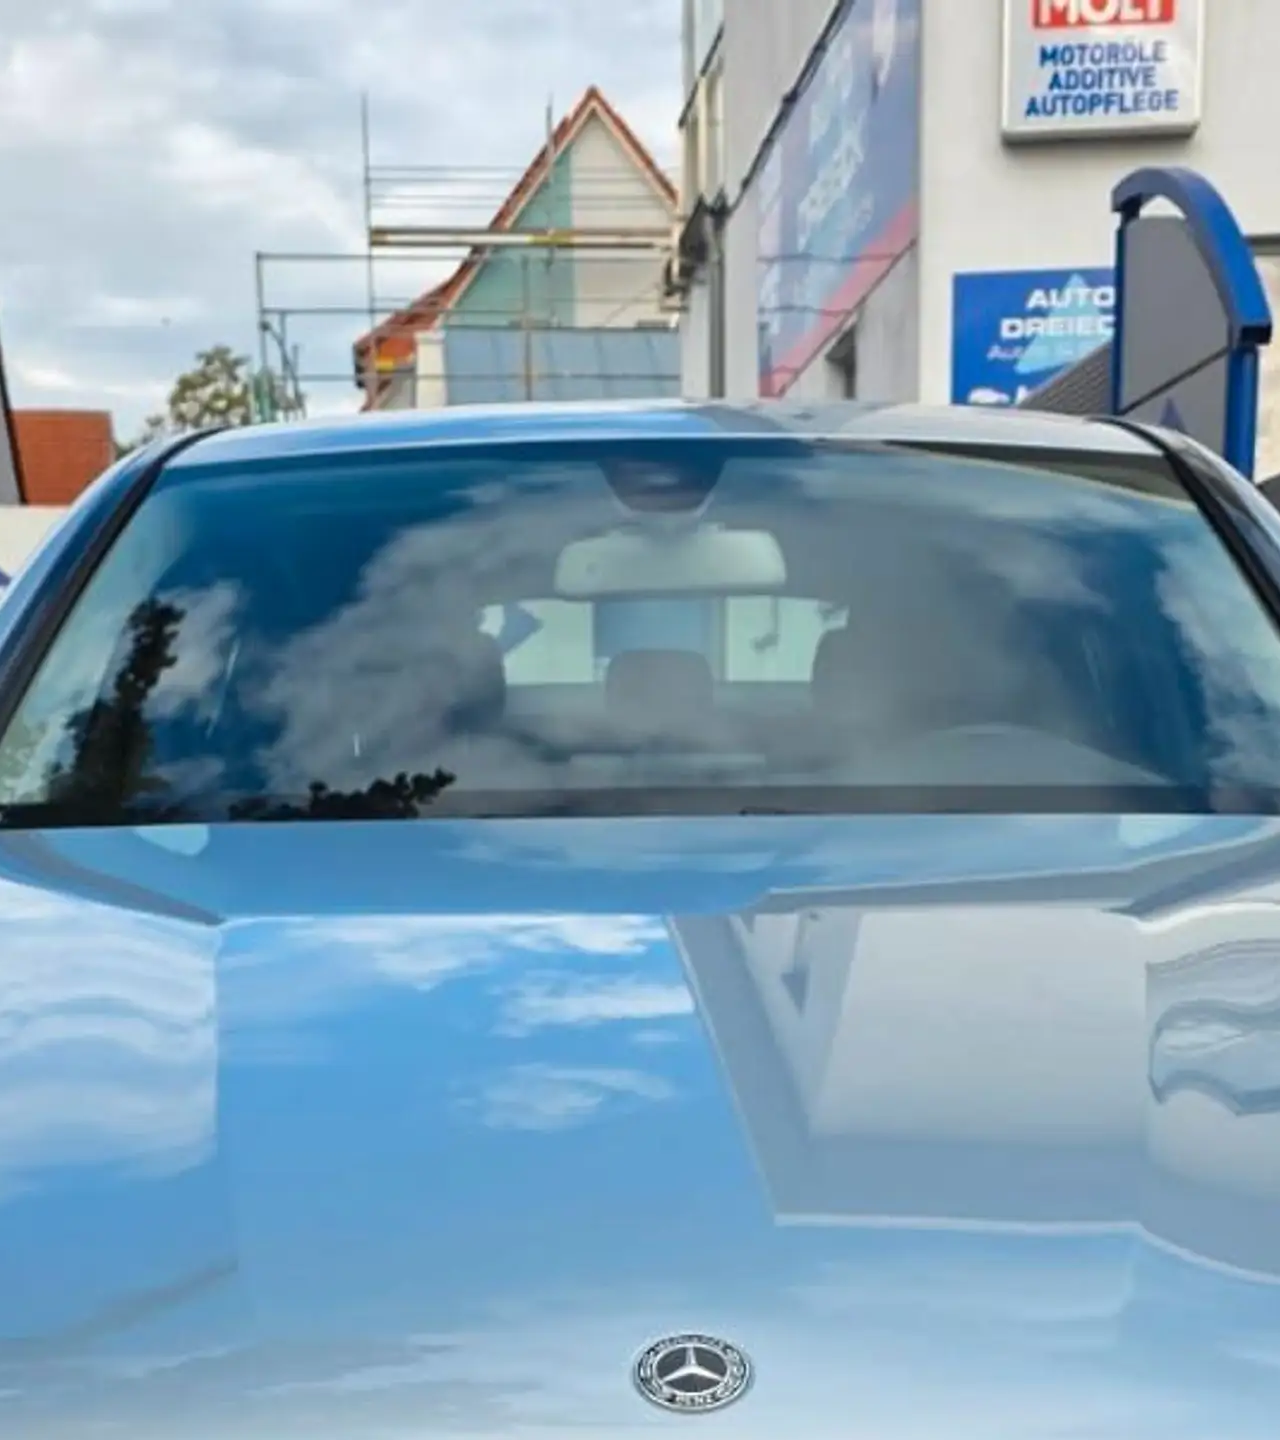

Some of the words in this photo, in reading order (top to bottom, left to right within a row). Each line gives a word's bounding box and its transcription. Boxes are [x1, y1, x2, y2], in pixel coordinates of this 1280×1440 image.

[1048, 66, 1156, 91] ADDITIVE
[1025, 89, 1179, 118] AUTOPFLEGE
[1026, 286, 1115, 309] AUTO
